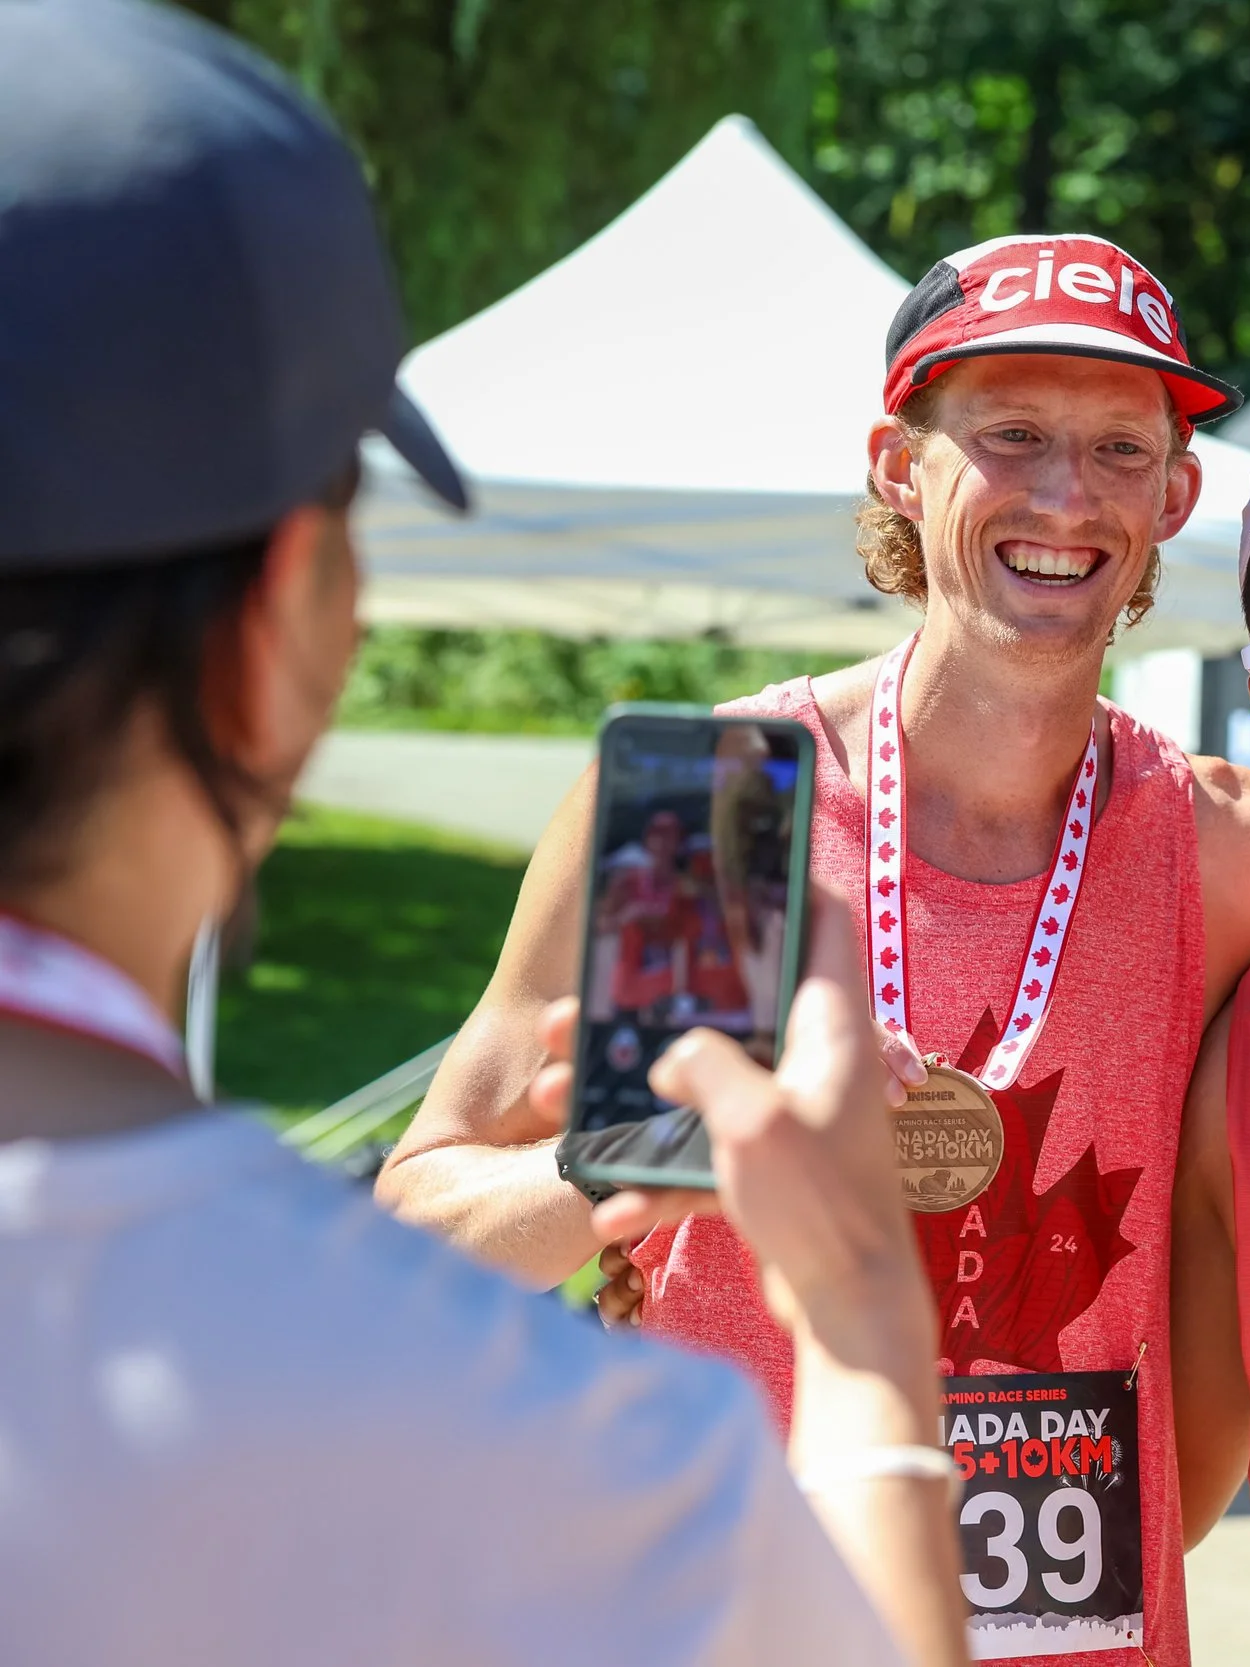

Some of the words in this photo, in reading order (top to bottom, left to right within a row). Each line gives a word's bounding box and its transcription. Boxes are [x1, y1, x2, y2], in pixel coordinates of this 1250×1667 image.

[979, 250, 1173, 345] ciele
[907, 1091, 956, 1102] INISHER
[896, 1130, 949, 1145] NADA
[954, 1129, 991, 1142] DAY
[913, 1141, 993, 1160] 5+10KM
[1050, 1234, 1077, 1253] 24
[940, 1391, 985, 1405] AMINO
[988, 1389, 1023, 1402] RACE
[1025, 1388, 1067, 1401] SERIES
[1041, 1408, 1110, 1442] DAY
[954, 1436, 1113, 1481] 5+10KM
[959, 1487, 1103, 1608] 39
